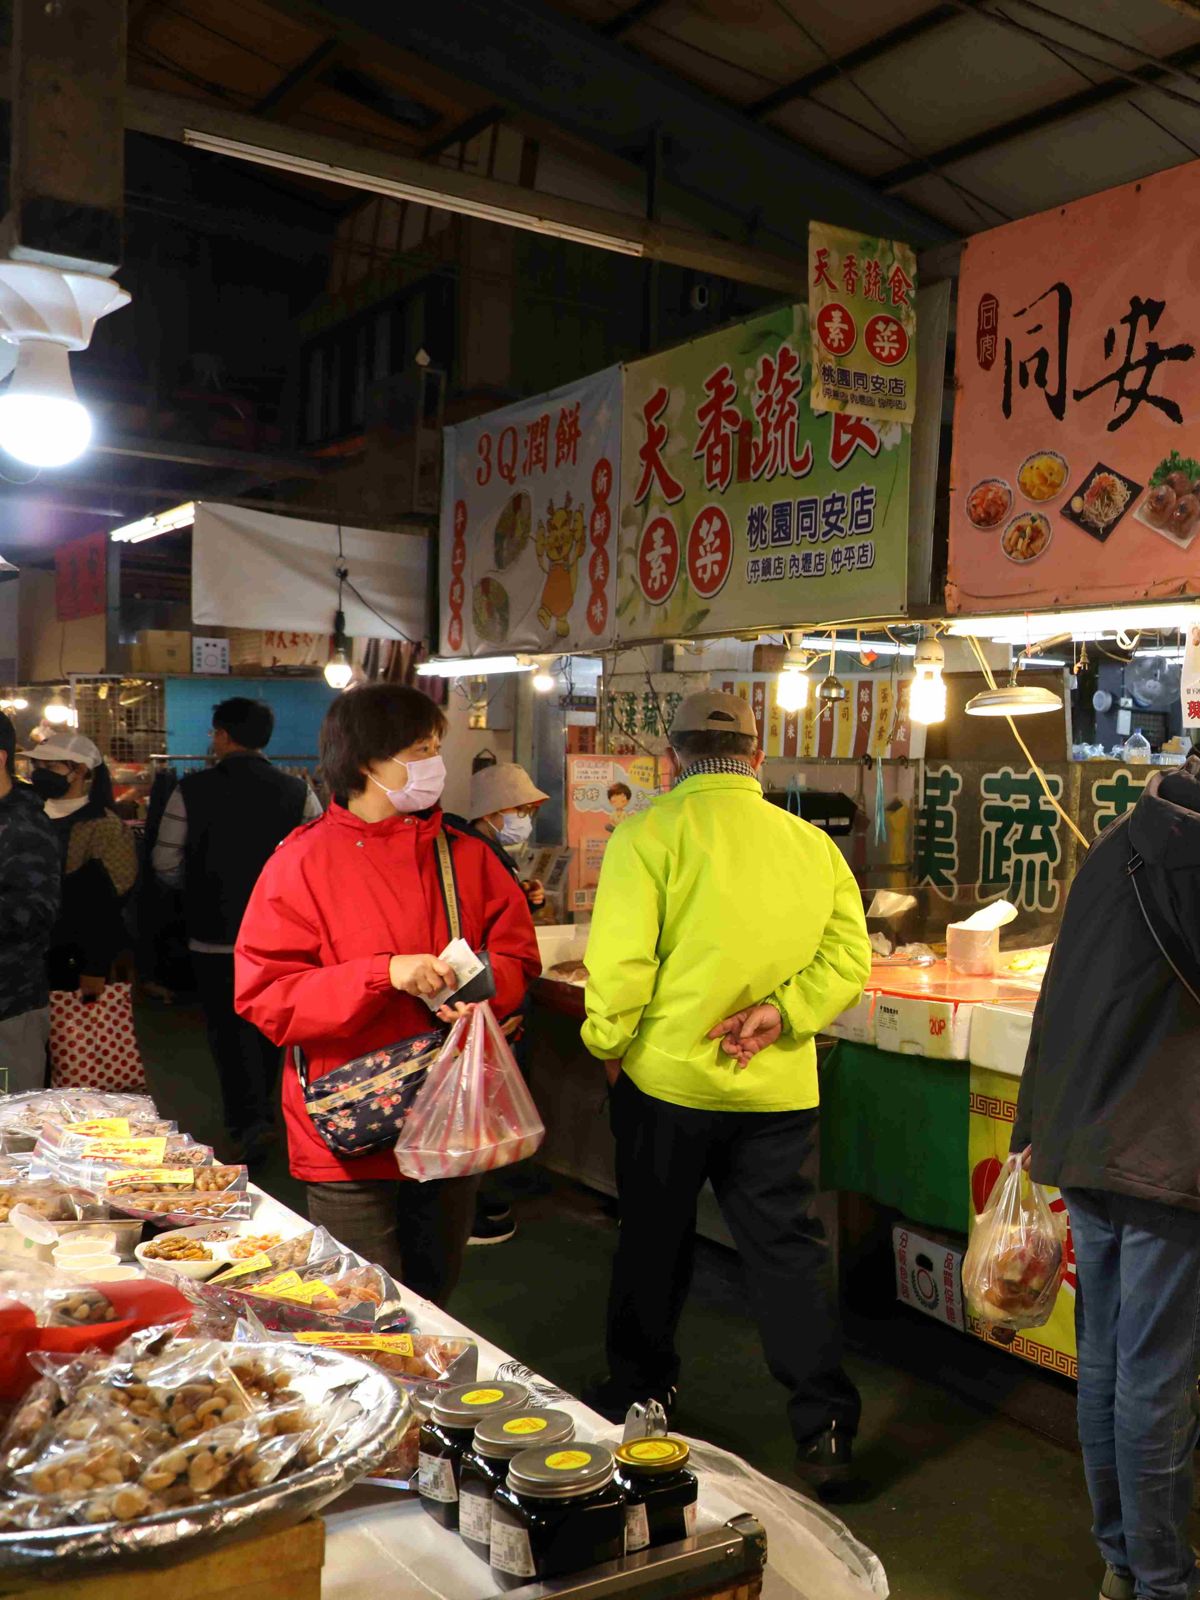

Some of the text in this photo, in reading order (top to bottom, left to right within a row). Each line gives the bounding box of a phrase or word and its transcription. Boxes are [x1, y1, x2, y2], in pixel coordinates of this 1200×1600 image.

[814, 248, 912, 306] 天香蔬食
[822, 364, 905, 396] 桃園同安店
[746, 486, 875, 548] 桃園同安店
[928, 1017, 947, 1036] 20P
